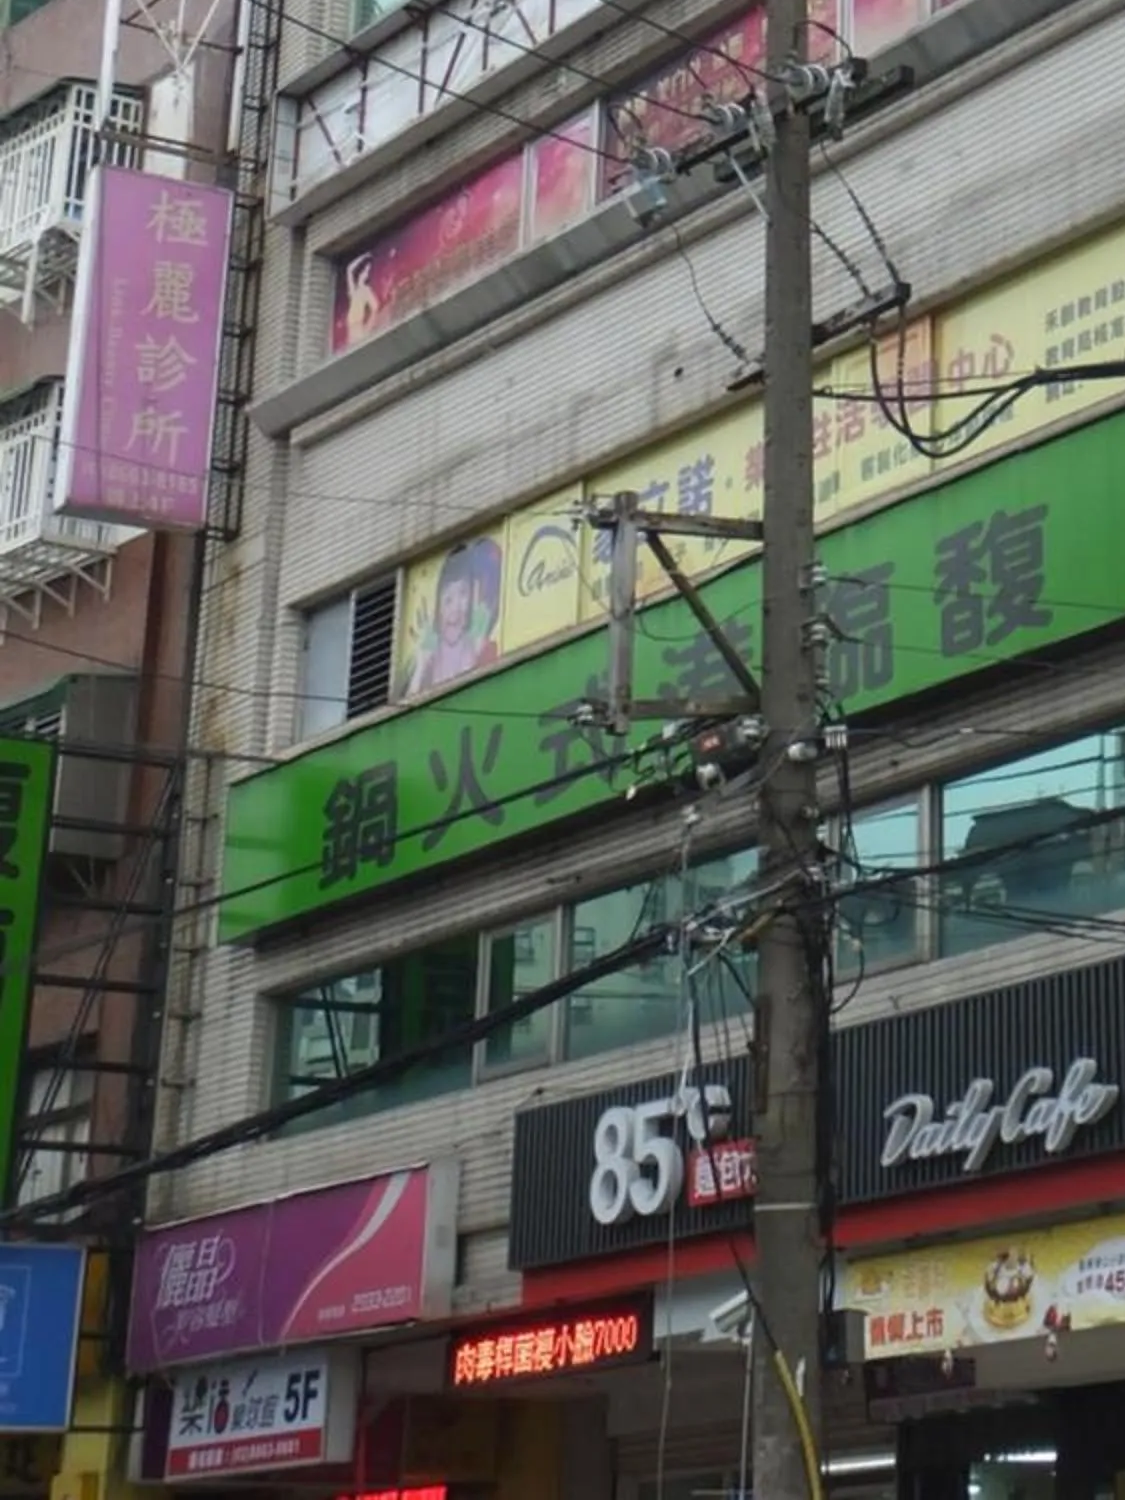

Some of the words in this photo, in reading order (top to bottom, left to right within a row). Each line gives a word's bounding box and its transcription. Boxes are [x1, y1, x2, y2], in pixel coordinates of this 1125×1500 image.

[129, 188, 208, 468] 極麗診所
[880, 1077, 1005, 1171] Daily
[1001, 1057, 1119, 1152] Cafe
[284, 1369, 320, 1423] 5F
